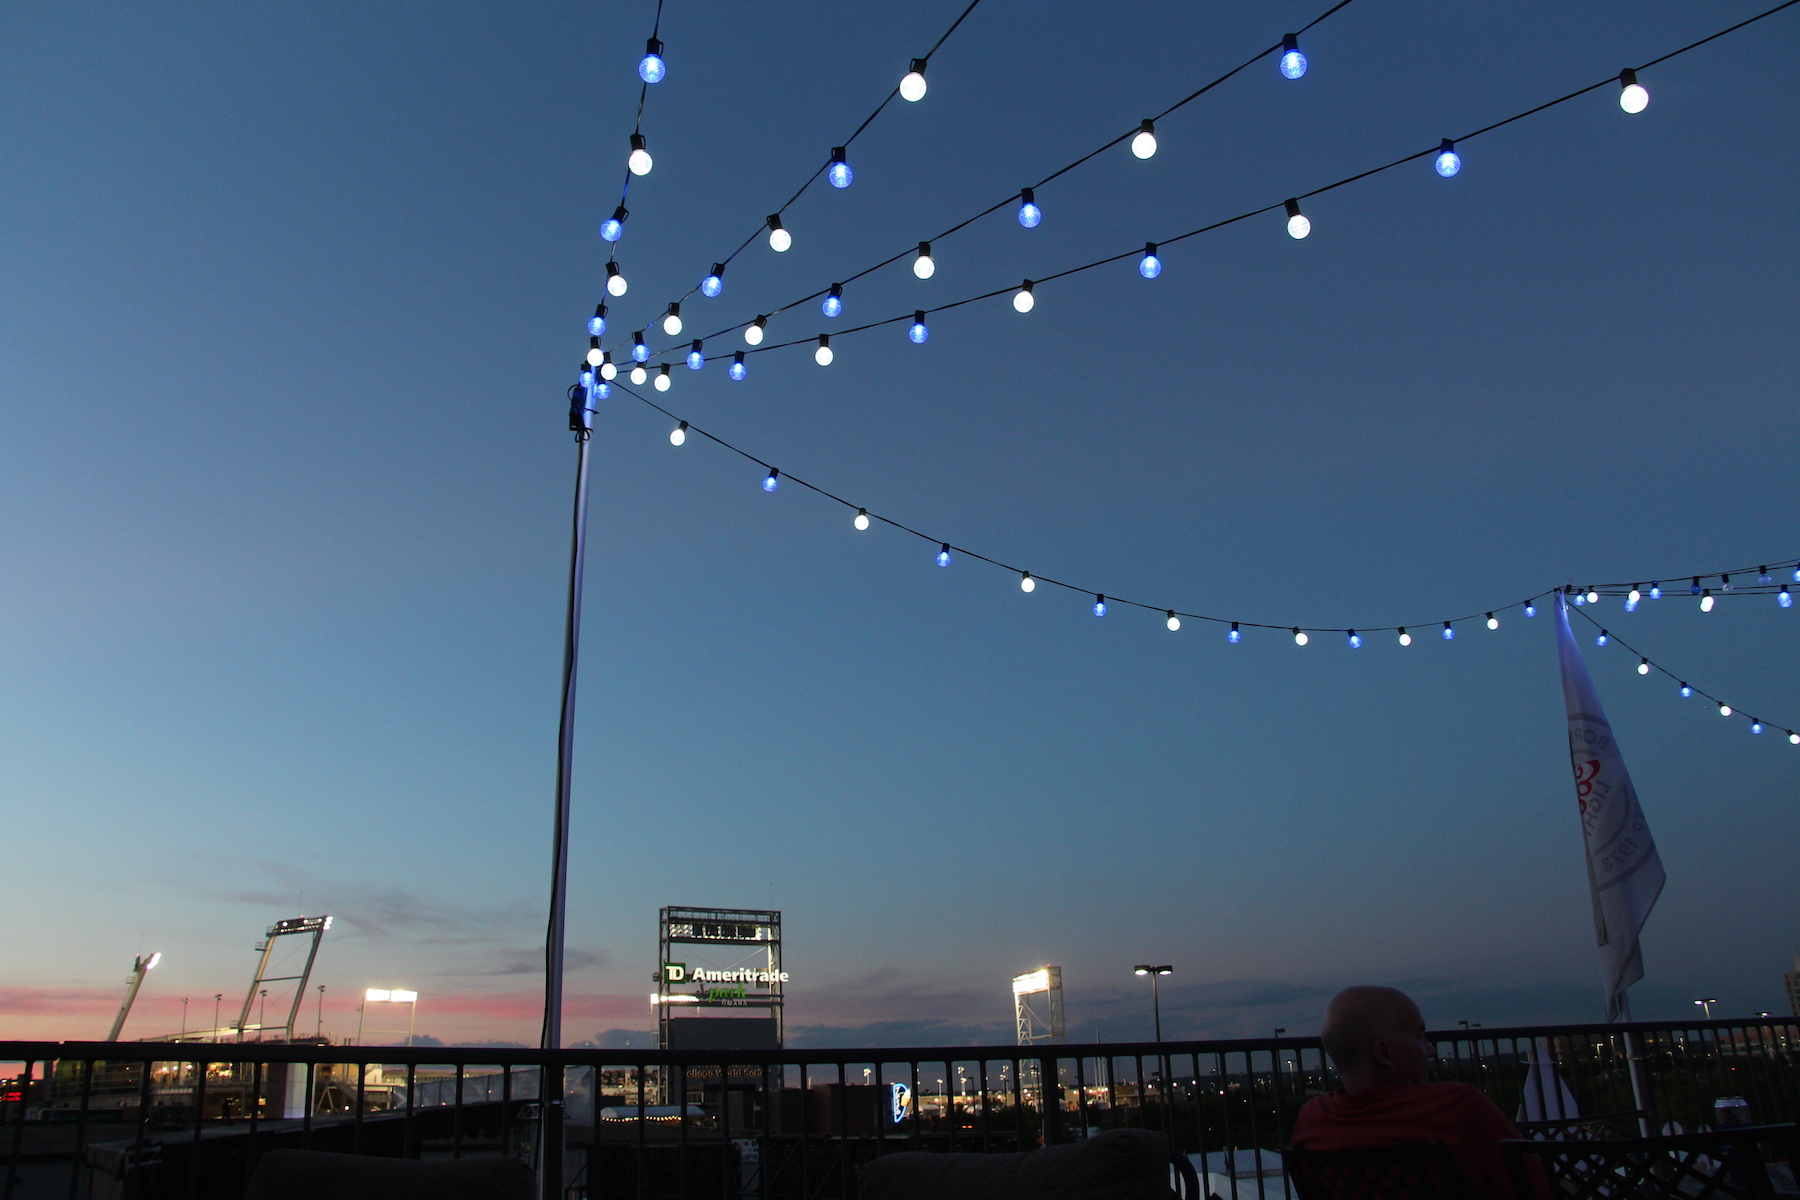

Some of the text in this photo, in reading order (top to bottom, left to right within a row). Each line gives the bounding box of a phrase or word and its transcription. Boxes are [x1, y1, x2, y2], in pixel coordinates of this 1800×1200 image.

[665, 965, 789, 982] TD Ameritrade
[709, 982, 747, 1003] park
